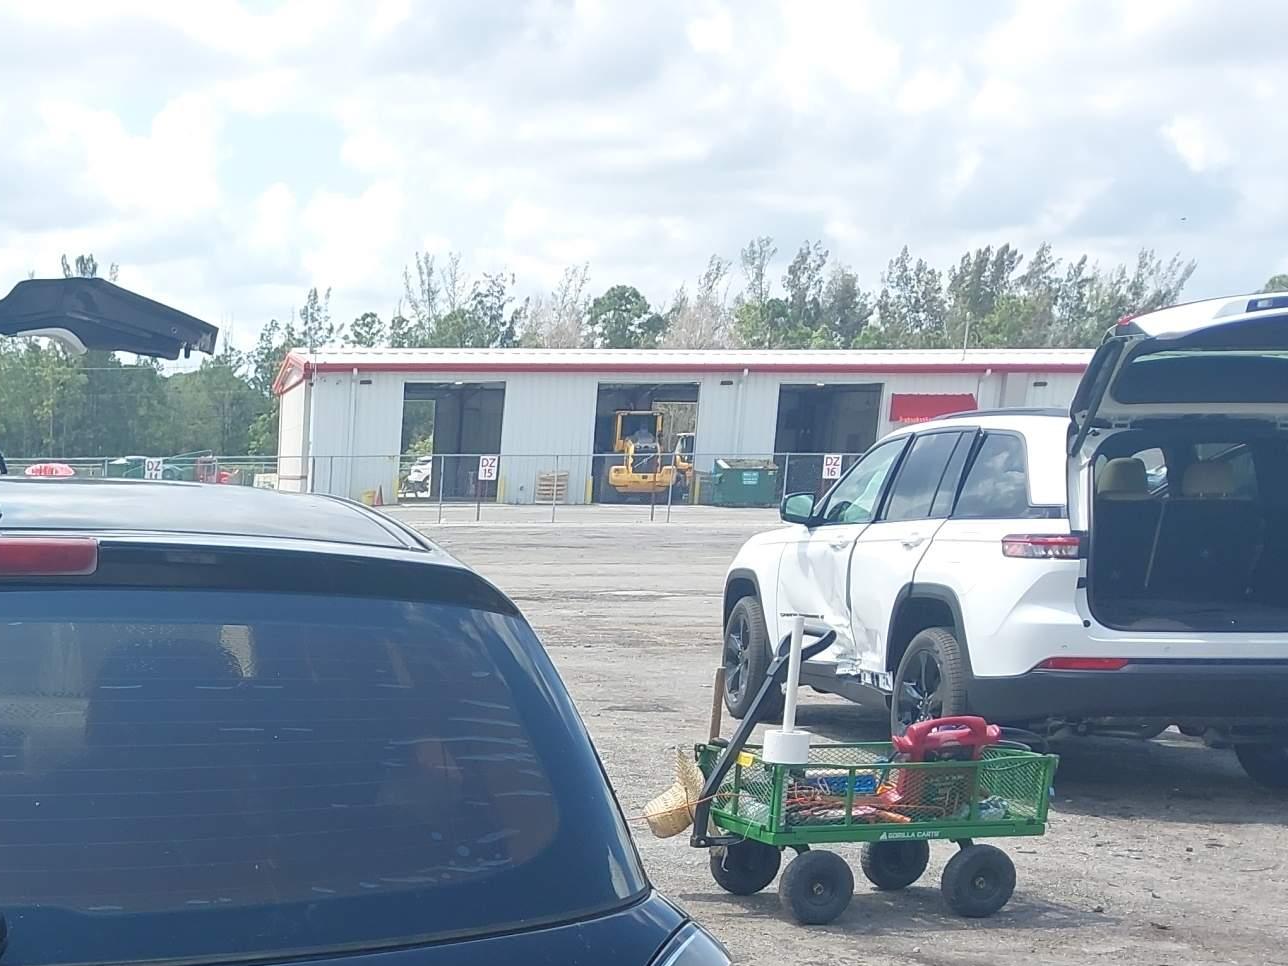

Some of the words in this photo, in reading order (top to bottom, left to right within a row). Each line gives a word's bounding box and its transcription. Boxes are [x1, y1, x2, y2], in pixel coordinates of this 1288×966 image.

[147, 461, 161, 471] DZ
[482, 458, 496, 468] DZ
[825, 457, 840, 466] DZ
[483, 469, 493, 478] 15
[826, 468, 836, 477] 16
